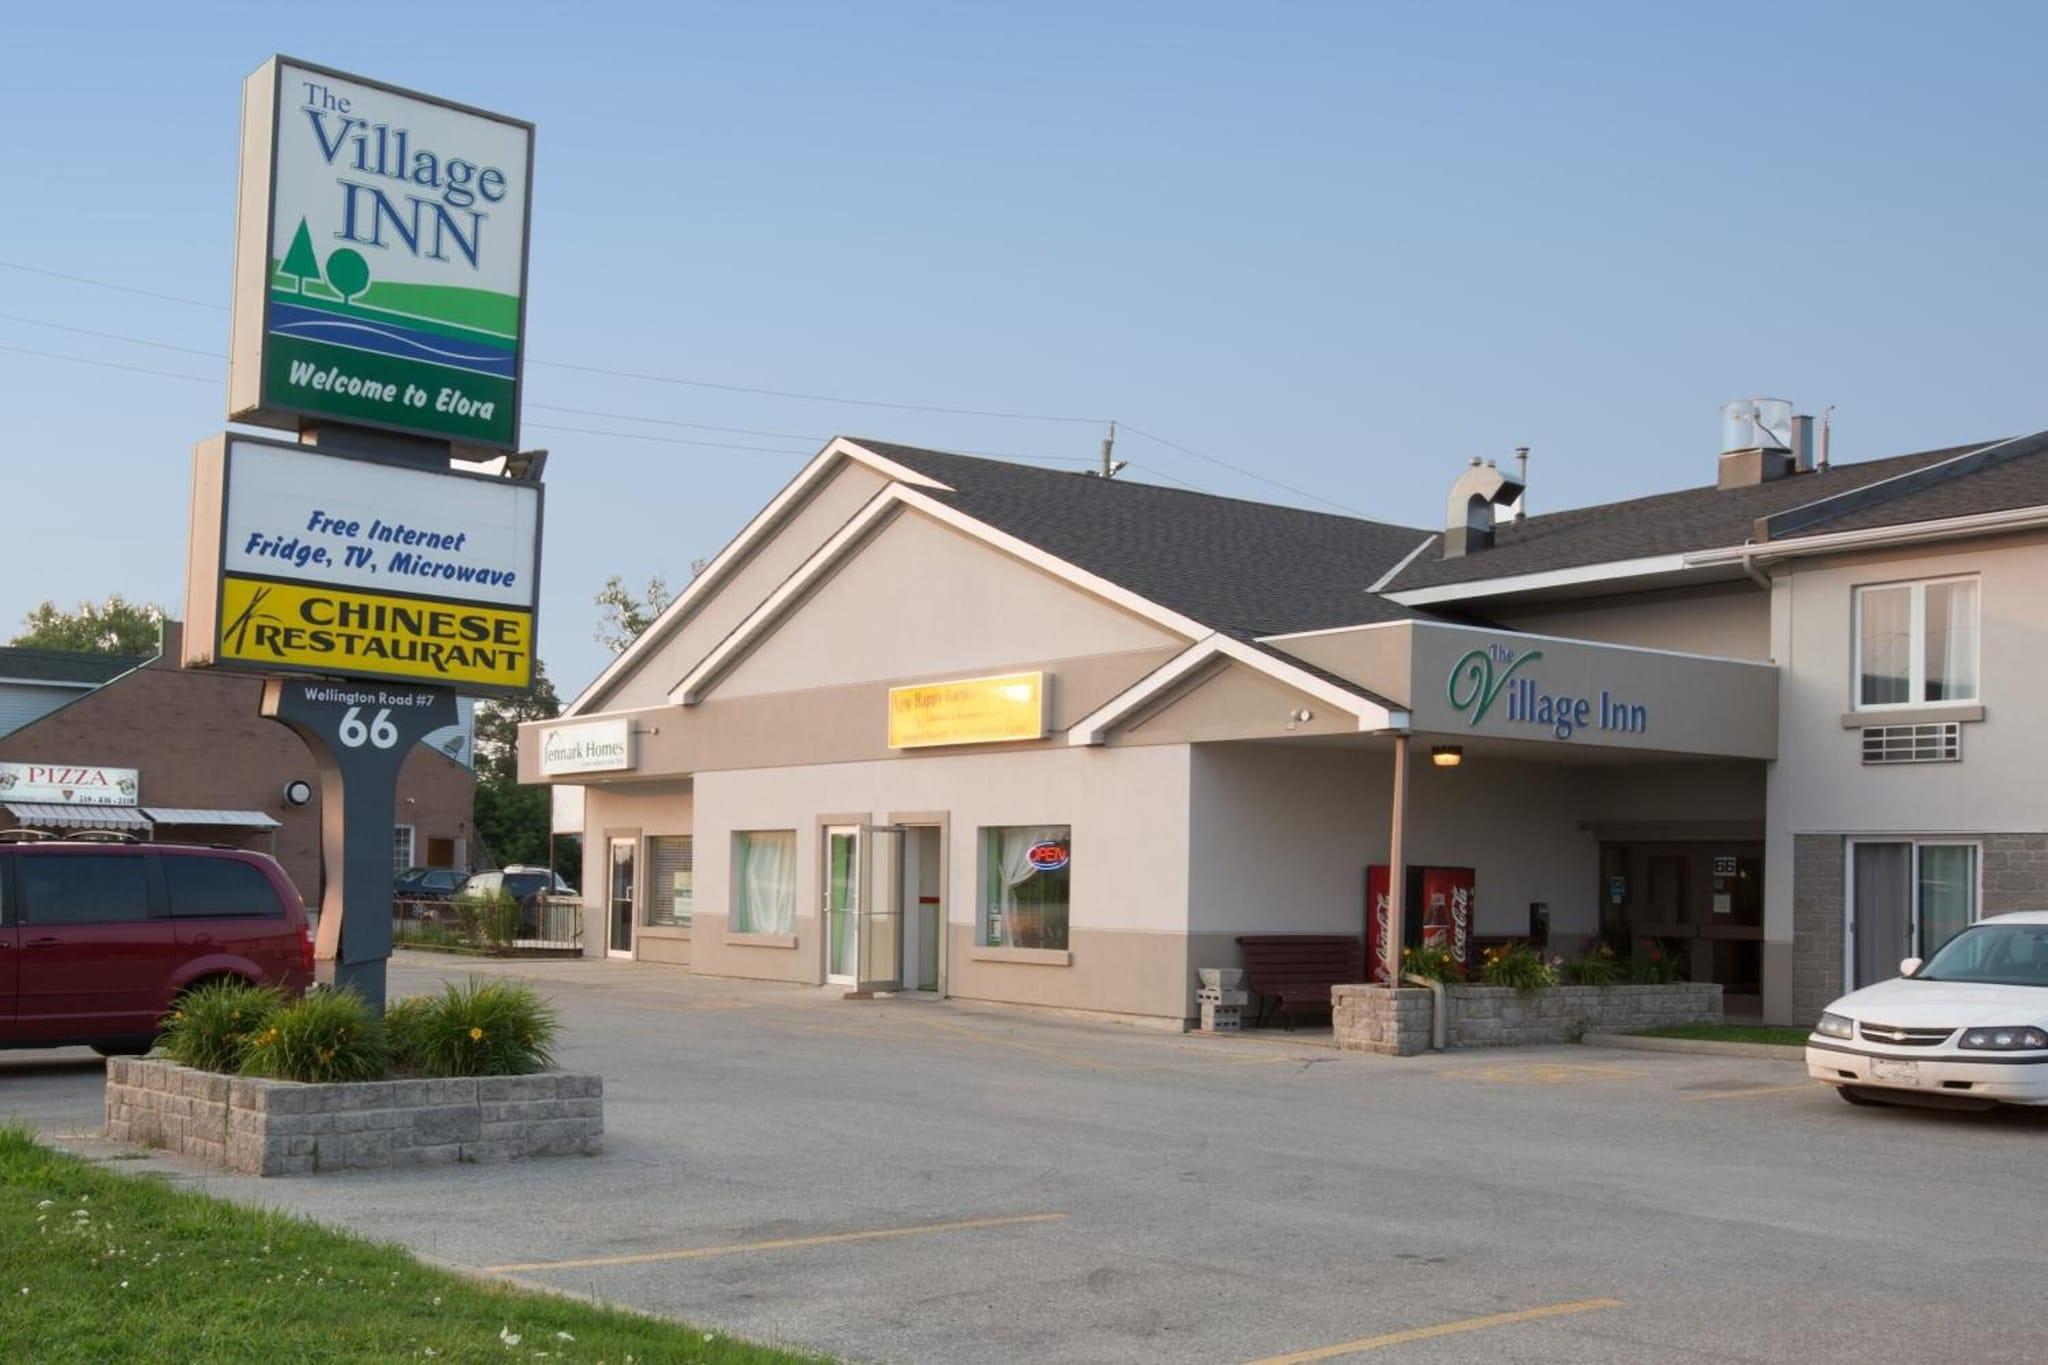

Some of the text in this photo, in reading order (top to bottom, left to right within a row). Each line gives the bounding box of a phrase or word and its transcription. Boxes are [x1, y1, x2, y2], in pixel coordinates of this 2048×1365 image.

[303, 82, 351, 113] The
[300, 105, 507, 207] Village
[334, 178, 488, 270] INN
[289, 360, 496, 421] Welcome to Elora
[307, 510, 466, 552] Free Internet
[245, 533, 516, 588] Fridge, TV, Microwave
[299, 597, 520, 646] CHINESE
[254, 621, 525, 672] RESTAURANT
[1489, 643, 1514, 662] The
[304, 687, 436, 707] Wellington Road #7
[1446, 649, 1647, 740] Village Inn
[338, 706, 398, 749] 66
[585, 740, 624, 758] Homes
[28, 766, 109, 786] PIZZA
[1715, 859, 1736, 874] 66
